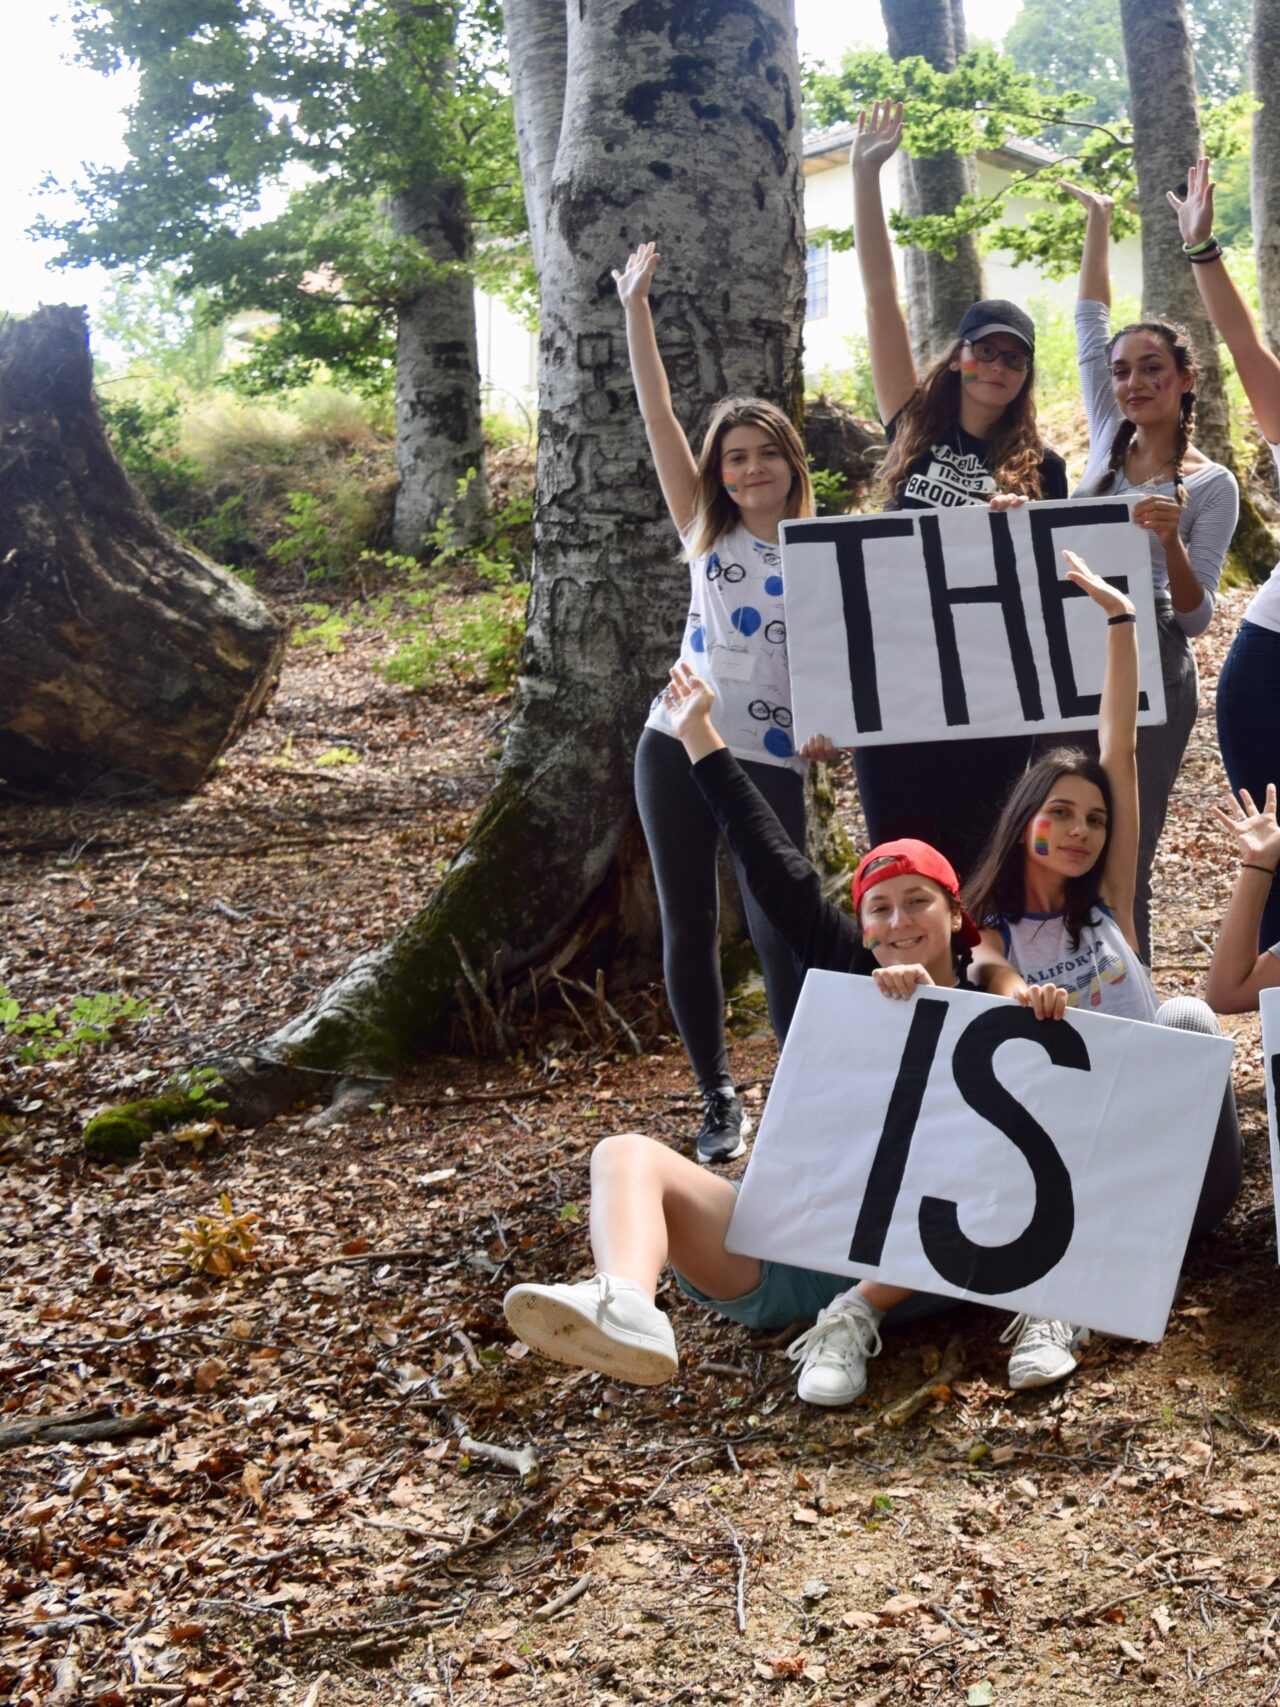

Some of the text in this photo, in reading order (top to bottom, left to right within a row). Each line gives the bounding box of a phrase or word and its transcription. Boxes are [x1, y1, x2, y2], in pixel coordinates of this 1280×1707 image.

[907, 476, 976, 508] BROOK
[785, 502, 1149, 734] THE
[1020, 940, 1105, 984] ALIFOR
[848, 998, 1091, 1295] IS
